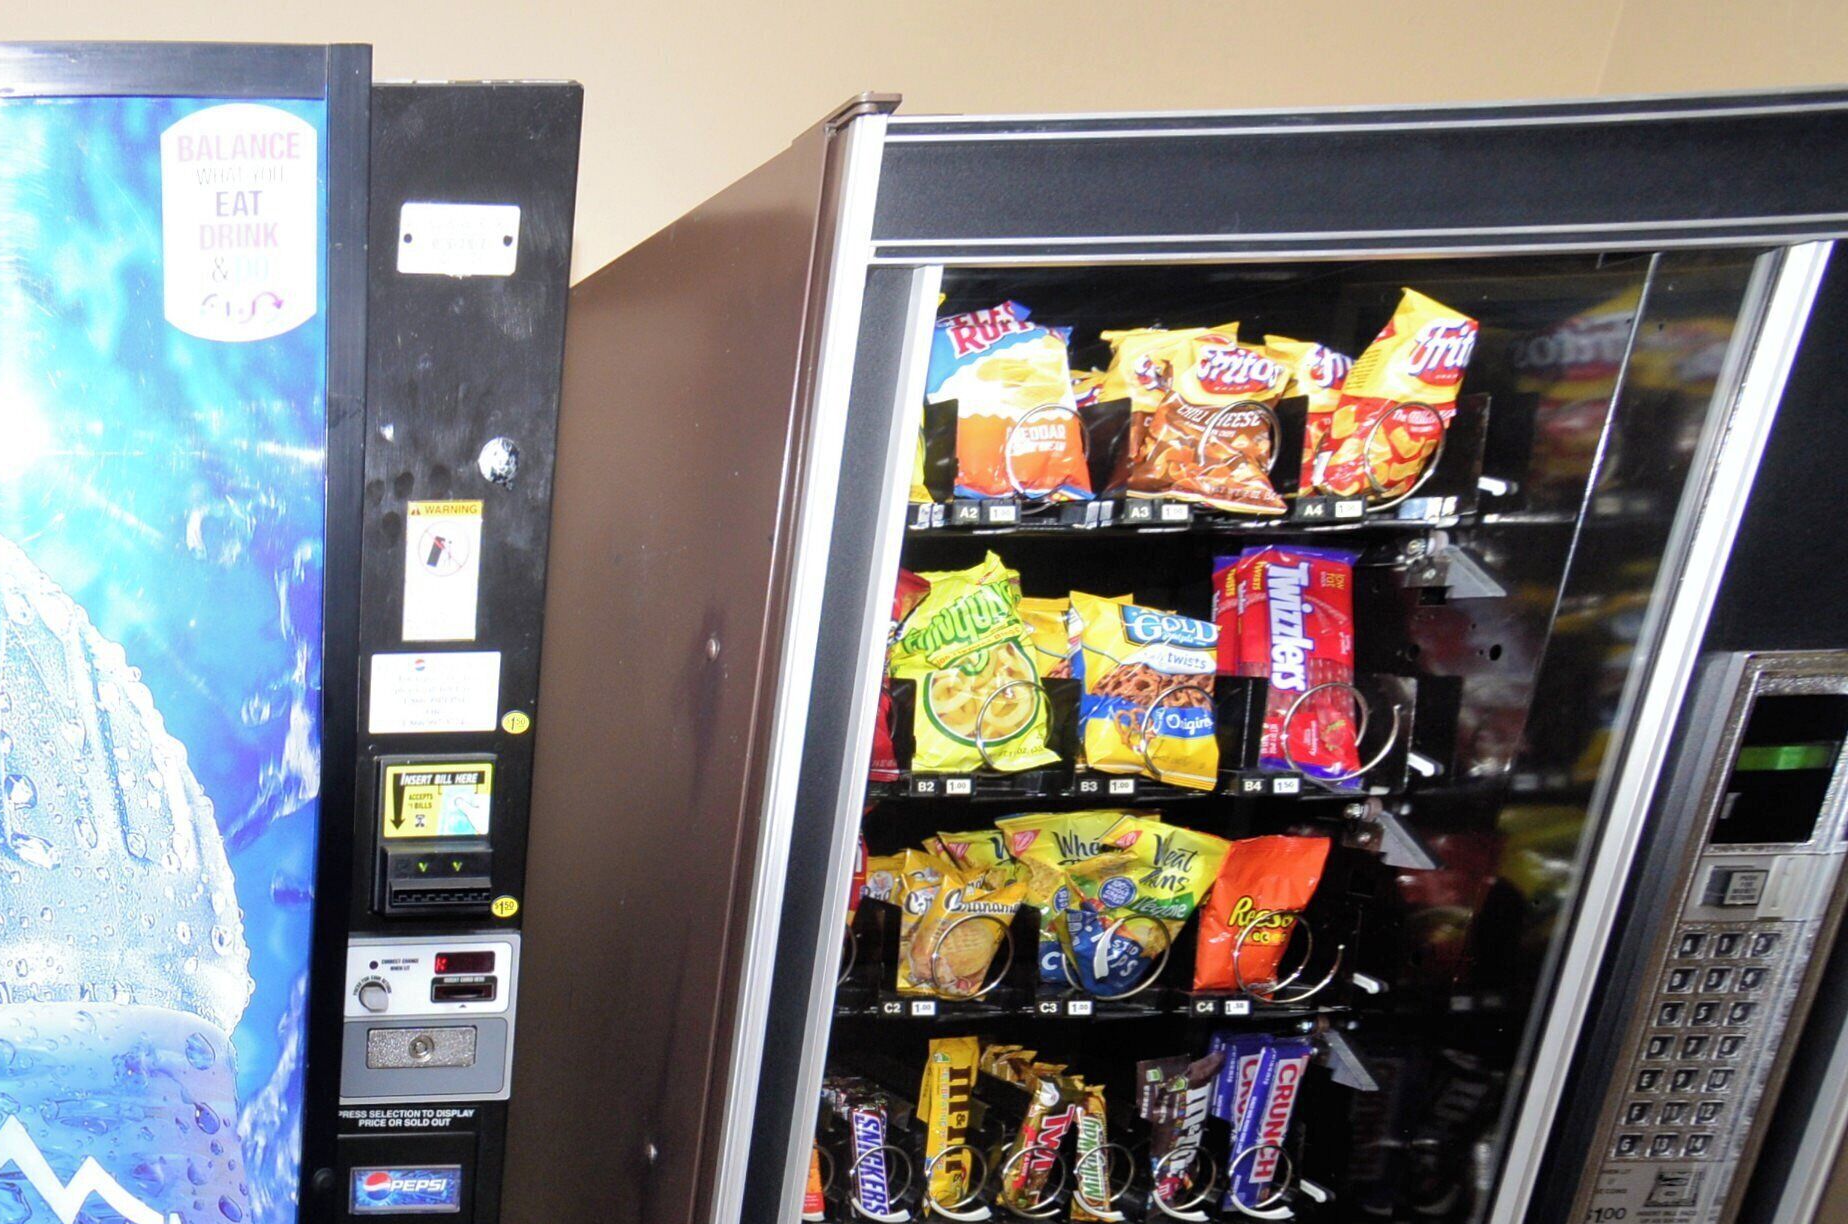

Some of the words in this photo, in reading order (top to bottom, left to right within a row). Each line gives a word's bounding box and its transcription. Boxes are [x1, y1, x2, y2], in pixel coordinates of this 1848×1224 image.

[176, 132, 301, 162] BALANCE
[215, 190, 263, 217] EAT
[199, 222, 279, 250] DRINK
[211, 256, 228, 282] &
[1409, 319, 1477, 377] Frit
[1177, 404, 1208, 423] CHILI
[1006, 424, 1065, 440] CEDDAR
[425, 504, 478, 515] WARNING
[960, 507, 977, 518] A2
[1130, 507, 1149, 518] A3
[1304, 506, 1324, 516] A4
[1134, 614, 1218, 643] GOLD
[1265, 561, 1315, 692] Twizzlers
[1168, 653, 1207, 669] twists
[400, 773, 432, 785] INSERT
[434, 774, 453, 784] BILL
[455, 773, 478, 783] HERE
[1081, 782, 1097, 791] B3
[918, 782, 934, 792] B2
[1244, 782, 1262, 792] B4
[1052, 831, 1103, 856] Whe
[884, 1003, 901, 1013] C2
[1040, 1003, 1056, 1013] C3
[1196, 1003, 1213, 1012] C4
[369, 1110, 421, 1118] SELECTION
[423, 1109, 434, 1117] TO
[436, 1109, 475, 1117] DISPLAY
[1255, 1063, 1298, 1179] CRUNCH
[359, 1118, 386, 1127] PRICE
[389, 1118, 402, 1126] OR
[404, 1118, 430, 1126] SOLD
[432, 1118, 451, 1126] OUT
[855, 1114, 888, 1216] SNICKERS
[391, 1178, 447, 1193] PEPSI
